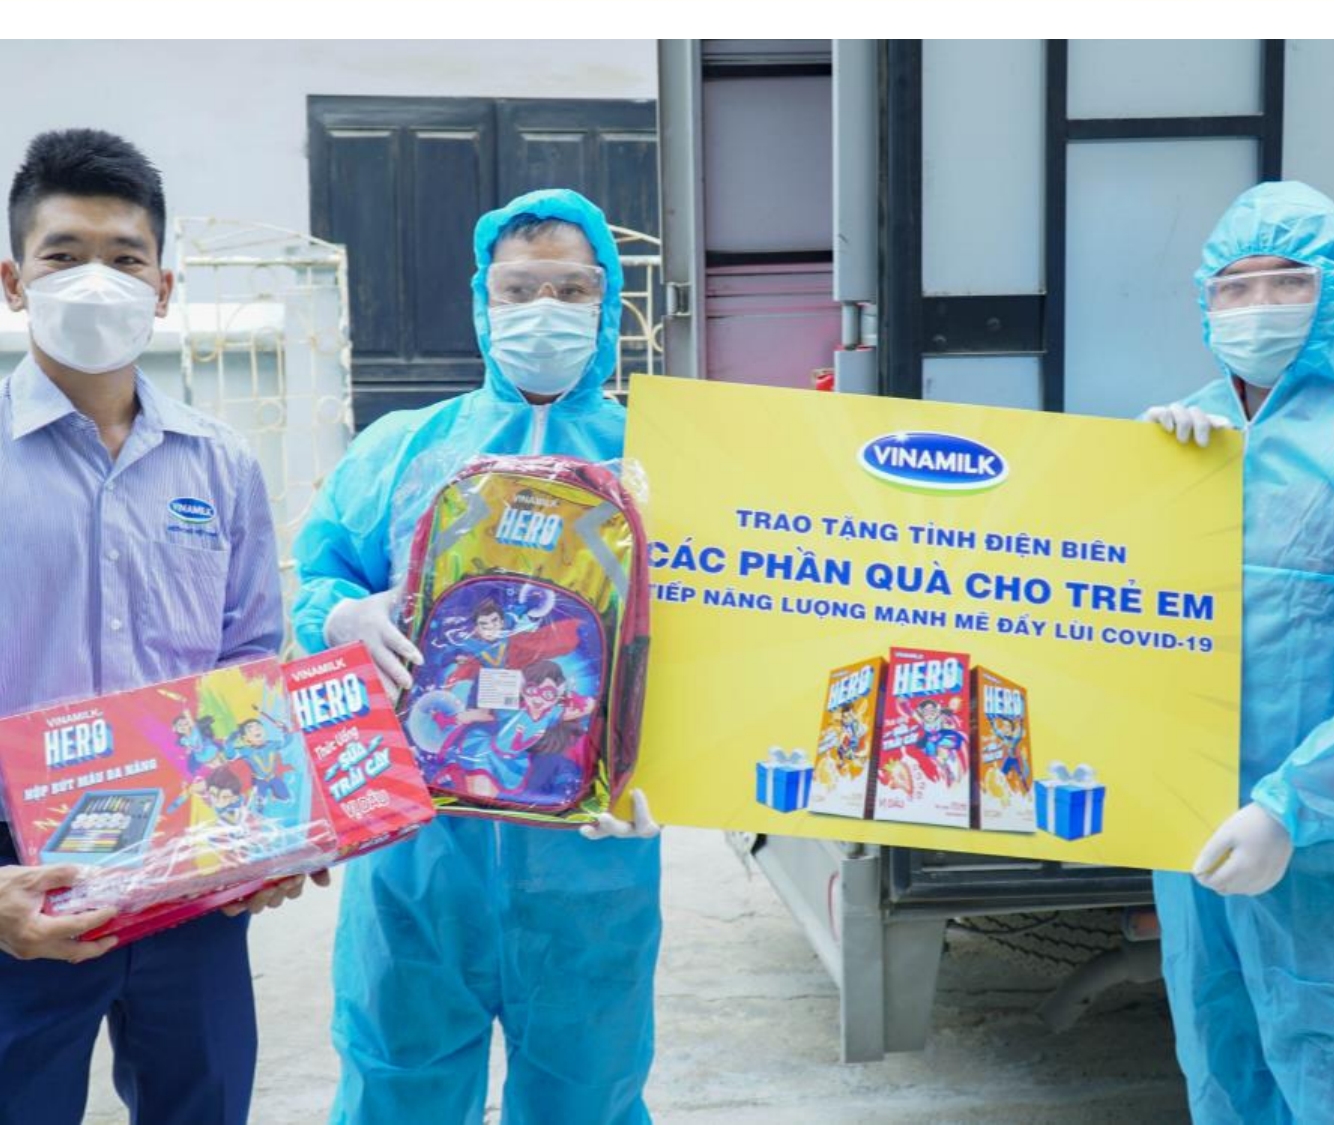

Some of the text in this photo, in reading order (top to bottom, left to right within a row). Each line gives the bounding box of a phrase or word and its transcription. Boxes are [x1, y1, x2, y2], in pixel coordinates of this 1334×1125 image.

[873, 442, 996, 477] VINAMILK
[495, 506, 564, 552] HERO
[736, 509, 812, 533] TRAO
[821, 515, 899, 542] TẶNG
[984, 532, 1051, 558] ĐIỆN
[1061, 539, 1127, 564] BIÊN
[648, 537, 1214, 621] CÁC PHẦN QUÀ CHO TRẺ EM
[875, 606, 946, 627] MẠNH
[1101, 627, 1214, 654] COVID-19
[291, 658, 347, 682] VINAMILK
[828, 664, 875, 713] HERO
[892, 657, 964, 699] HERO
[46, 708, 101, 728] VINAMILK
[292, 672, 370, 733] HERO
[983, 684, 1025, 720] HERO
[43, 719, 114, 769] HERO
